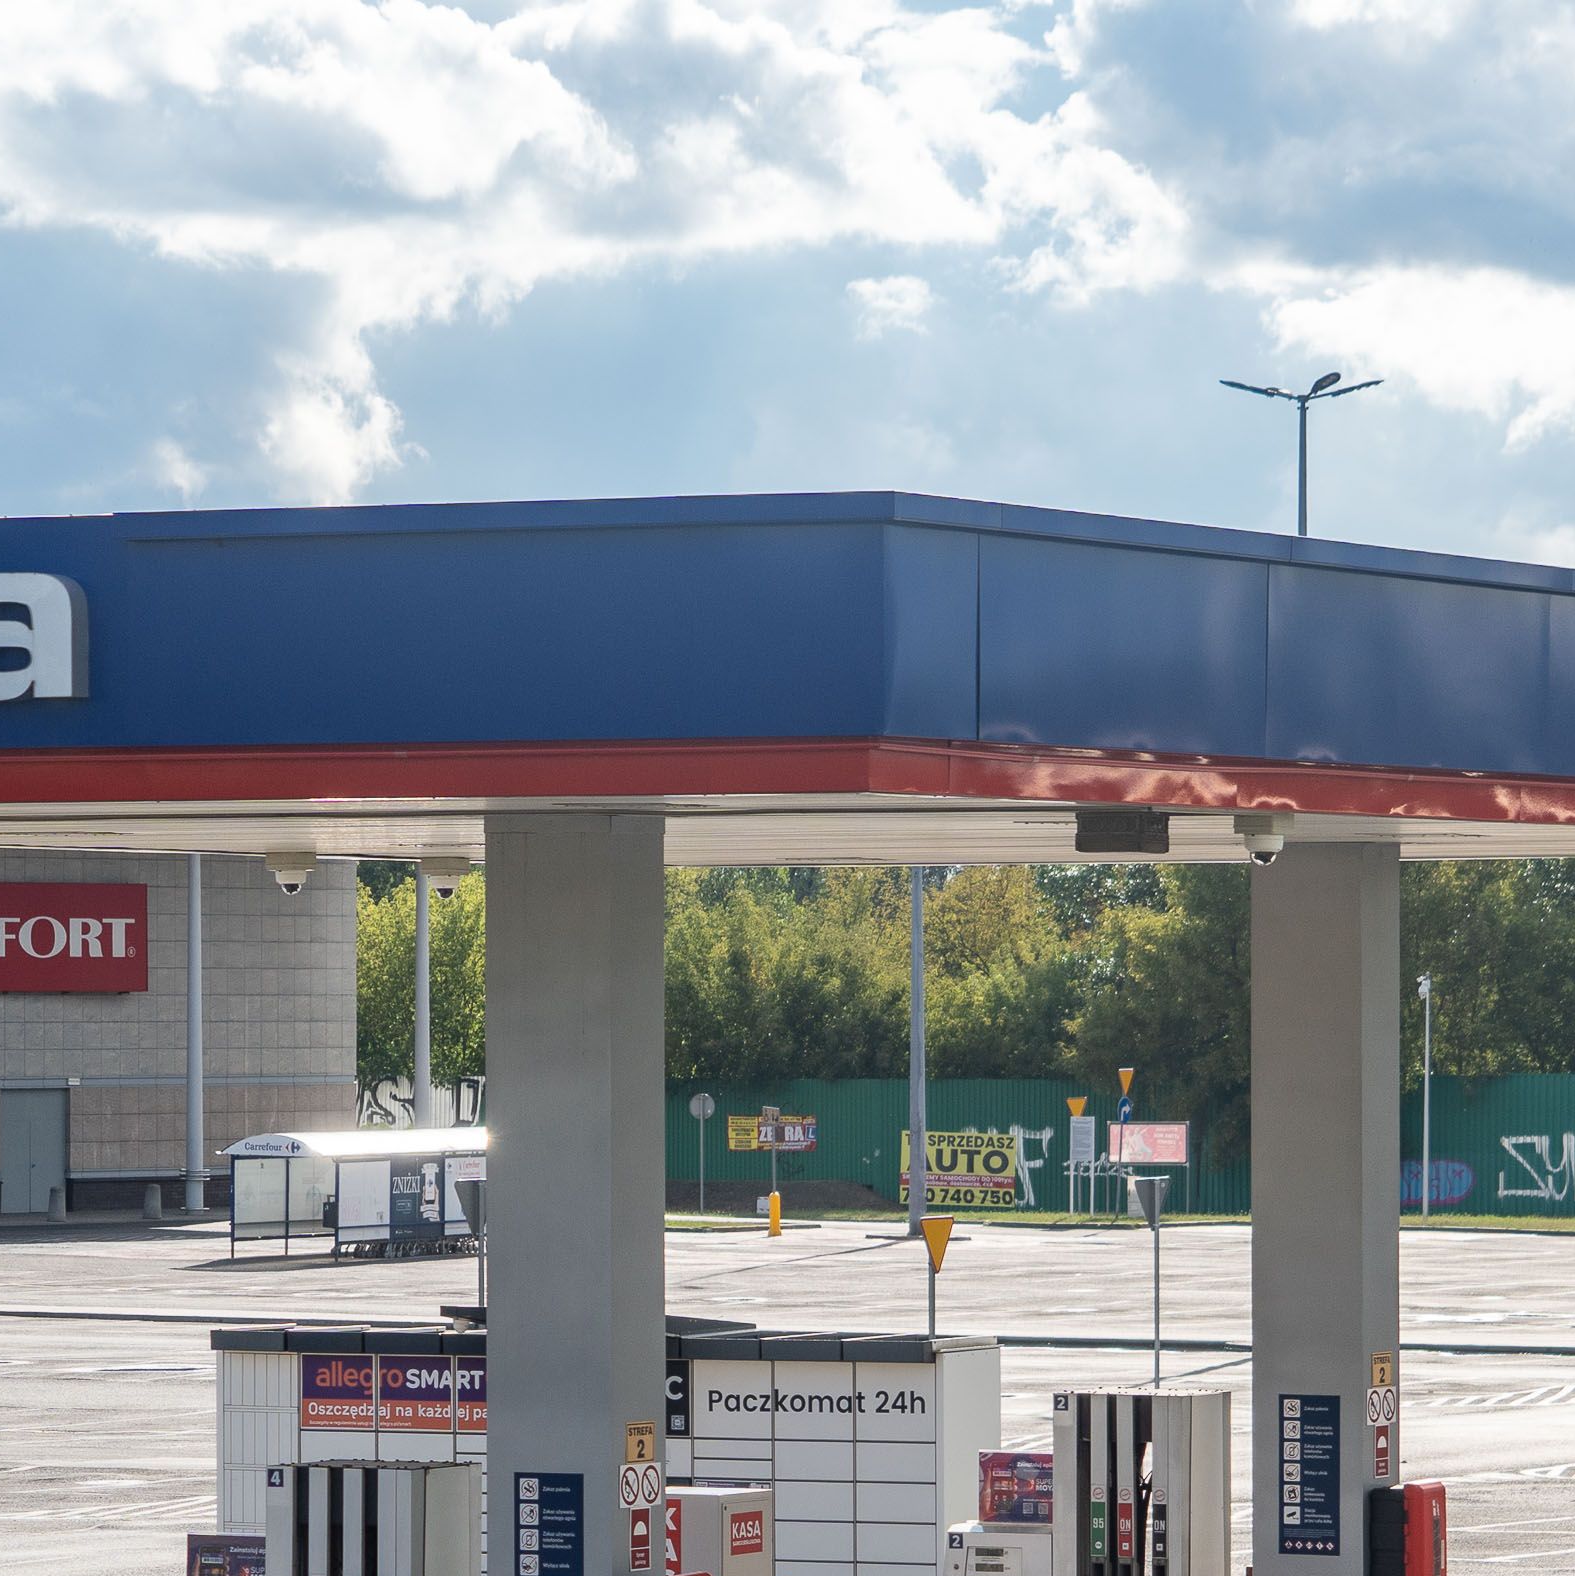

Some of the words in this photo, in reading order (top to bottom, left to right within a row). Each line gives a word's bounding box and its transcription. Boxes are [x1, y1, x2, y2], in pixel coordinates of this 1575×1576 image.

[759, 1126, 804, 1142] ZERA
[928, 1134, 1014, 1149] SPRZEDASZ
[244, 1142, 283, 1152] Carrefour
[392, 1171, 422, 1194] ZNIŻKI
[902, 1187, 935, 1204] 70
[939, 1188, 975, 1204] 740
[978, 1190, 1014, 1205] 750
[315, 1360, 404, 1395] allegro
[1379, 1367, 1386, 1384] 2
[708, 1388, 866, 1414] Paczkomat
[875, 1390, 926, 1414] 24h
[1057, 1396, 1065, 1411] 2
[308, 1402, 391, 1419] Oszczędzaj
[395, 1408, 413, 1417] na
[417, 1404, 470, 1421] każdej
[628, 1425, 653, 1437] STREFA
[636, 1439, 645, 1459] 2
[270, 1472, 281, 1486] 4
[1035, 1484, 1053, 1492] MOY
[732, 1520, 761, 1540] KASA
[1092, 1518, 1105, 1529] 95
[1119, 1519, 1131, 1530] ON
[1154, 1520, 1166, 1531] ON
[952, 1535, 961, 1547] 2
